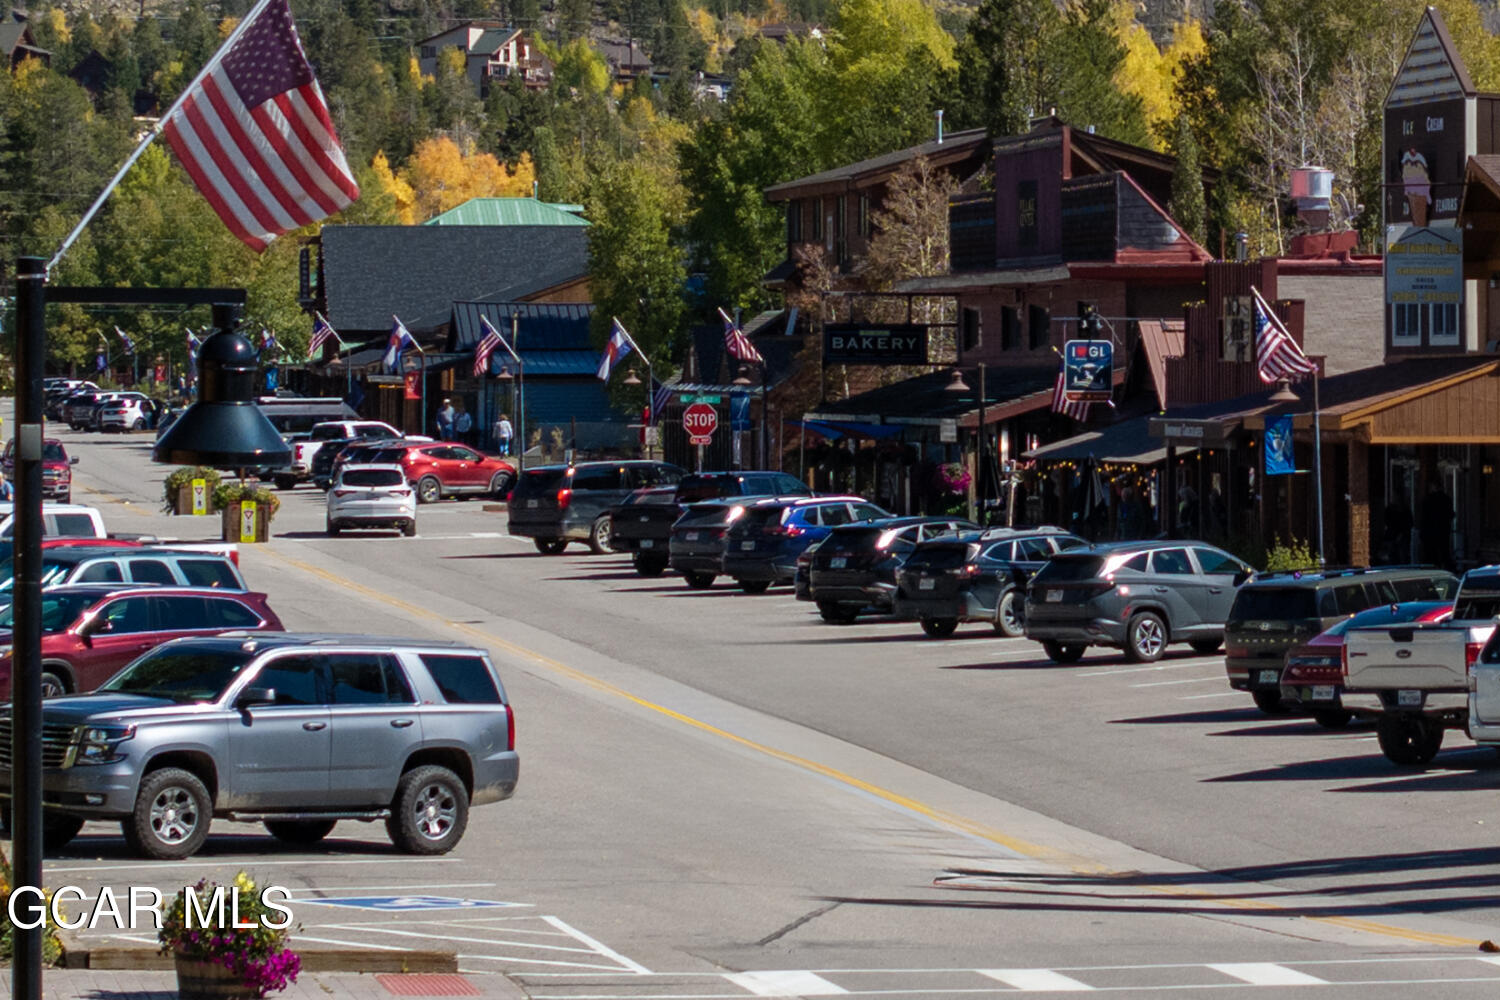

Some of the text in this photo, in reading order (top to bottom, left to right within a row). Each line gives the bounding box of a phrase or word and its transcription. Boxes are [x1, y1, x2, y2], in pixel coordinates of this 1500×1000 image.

[831, 336, 917, 350] BAKERY
[1071, 346, 1105, 358] I GL
[686, 413, 716, 427] STOP
